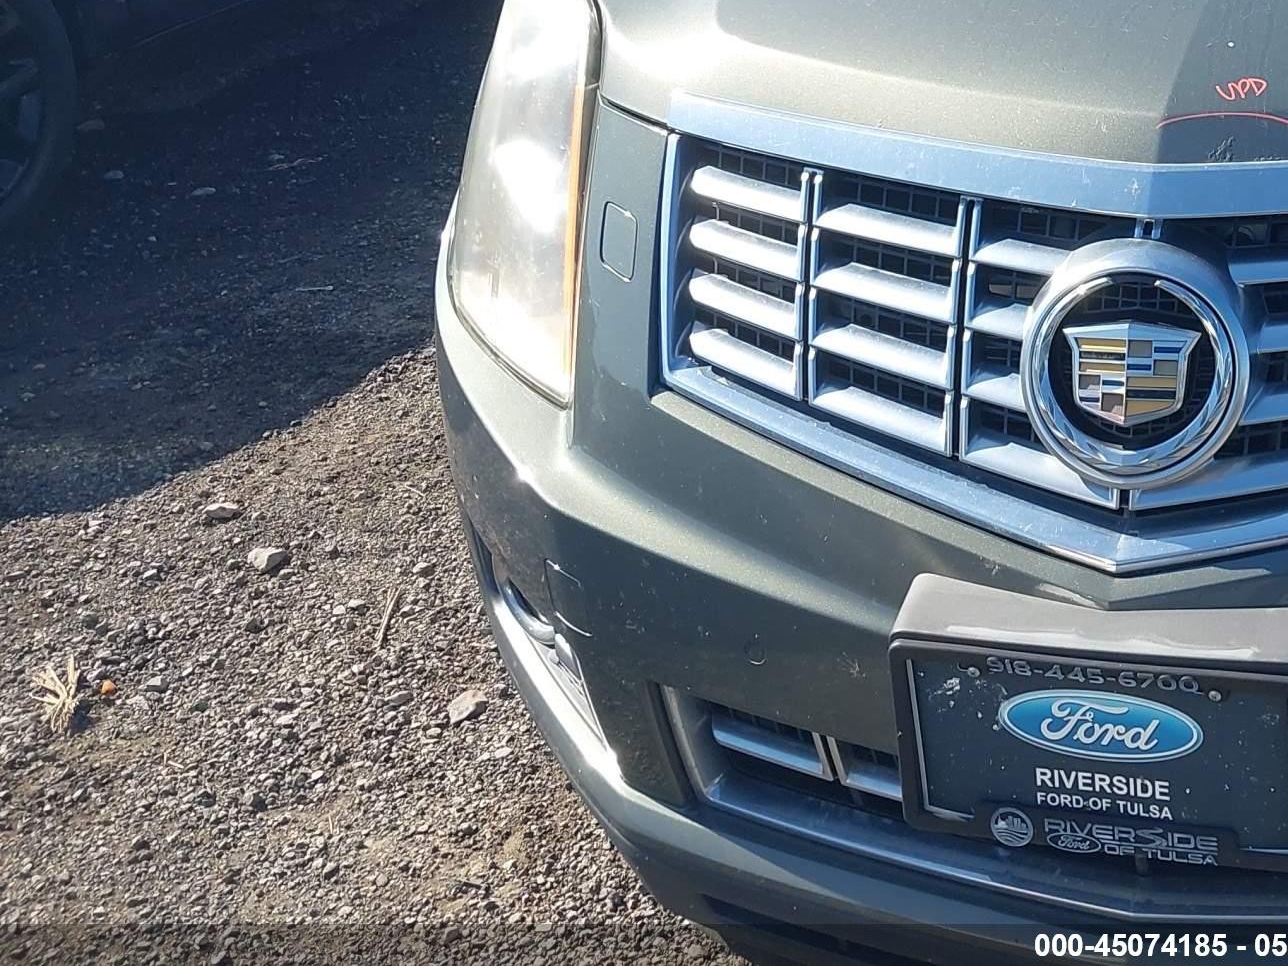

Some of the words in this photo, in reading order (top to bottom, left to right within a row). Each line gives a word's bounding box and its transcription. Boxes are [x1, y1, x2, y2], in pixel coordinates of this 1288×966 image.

[1215, 77, 1267, 101] UPD
[1040, 697, 1160, 751] Ford
[1035, 767, 1170, 801] RIVERSIDE
[1037, 792, 1083, 808] FORD
[1089, 797, 1112, 811] OF
[1116, 800, 1173, 821] TULSA
[1044, 818, 1218, 851] RIVERSIDE
[1104, 844, 1135, 856] OF
[1142, 848, 1218, 866] TULSA
